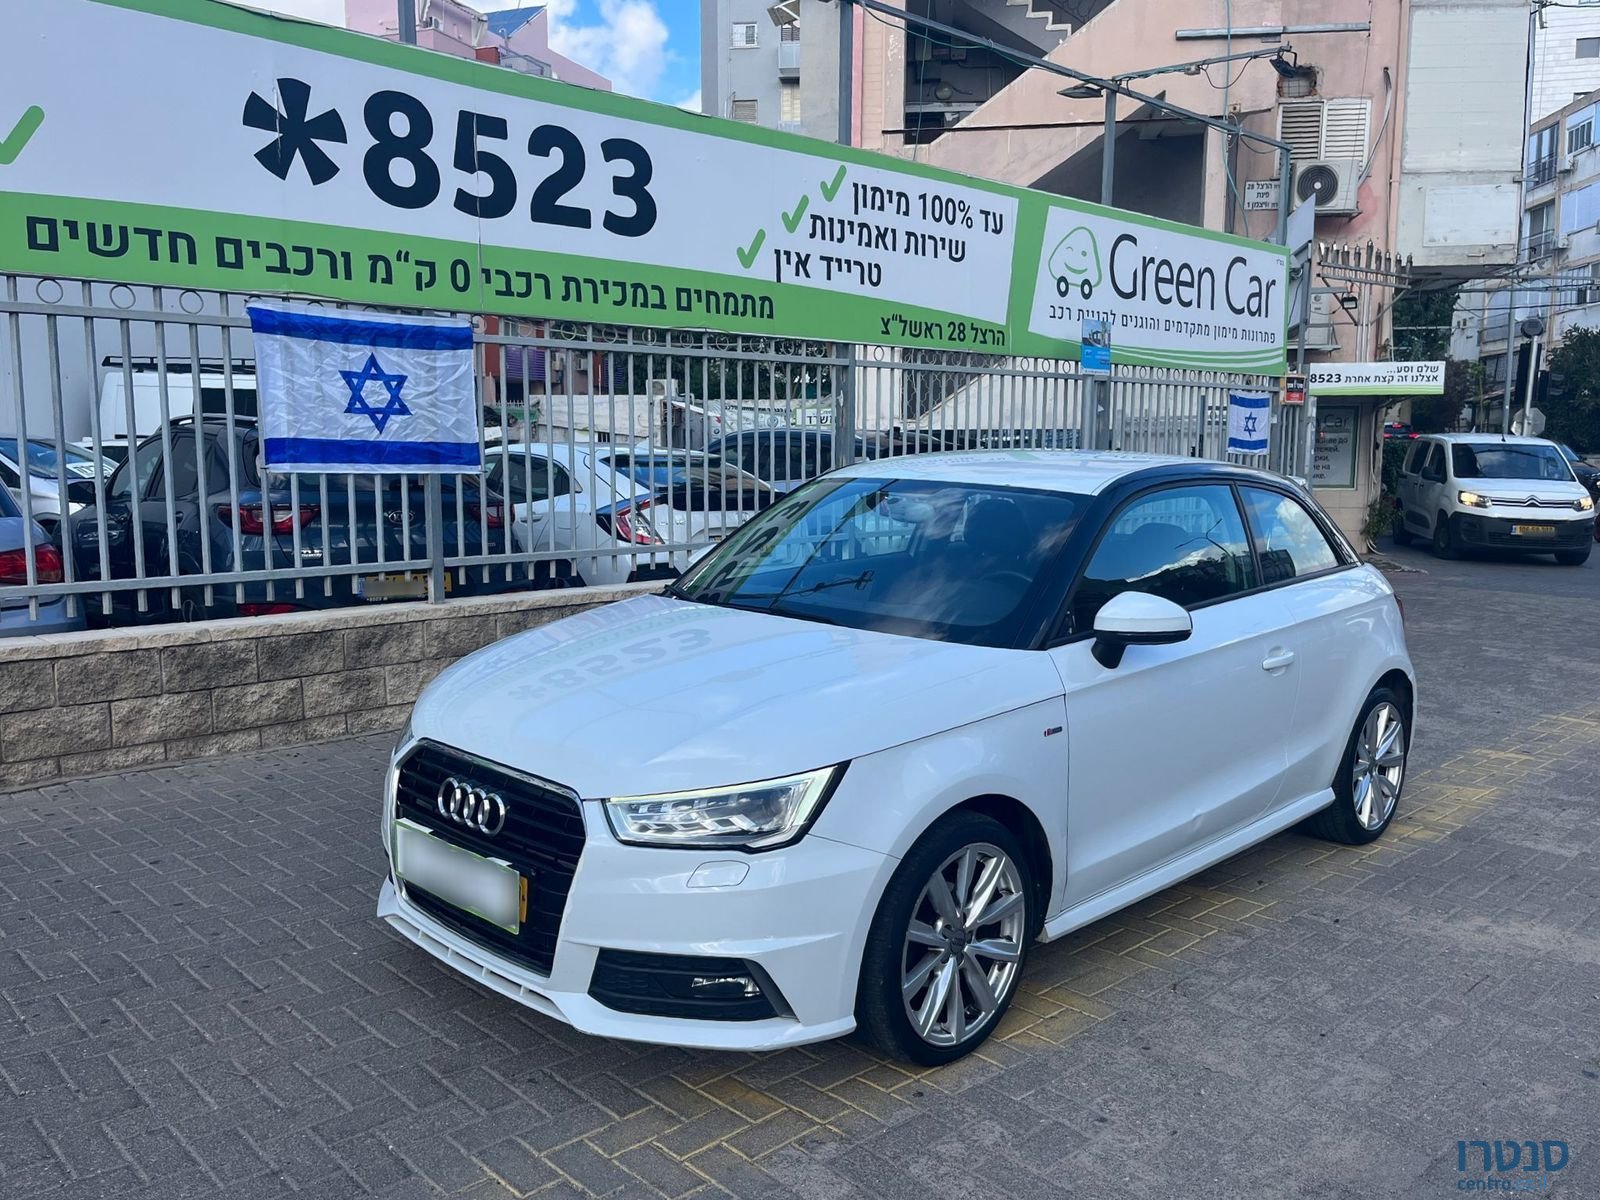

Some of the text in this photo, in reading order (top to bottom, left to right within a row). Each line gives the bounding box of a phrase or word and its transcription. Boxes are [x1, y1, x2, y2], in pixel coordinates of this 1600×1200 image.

[852, 182, 1004, 235] עד 100% מימון
[26, 215, 197, 265] חדשים
[809, 213, 966, 262] שירות ואמינות
[215, 236, 352, 281] ורכבים
[774, 248, 882, 287] טרייד אין
[450, 258, 470, 293] 0
[481, 267, 551, 300] רכבי
[1109, 233, 1276, 318] Green Car
[561, 275, 667, 310] במכירת
[676, 286, 774, 319] מתמחים
[1049, 304, 1072, 321] רכב
[1121, 313, 1160, 331] והוגנים
[947, 321, 966, 342] 28
[971, 322, 1005, 347] הרצל
[1164, 320, 1210, 340] מתקדמים
[1214, 322, 1238, 341] מימון
[1241, 327, 1276, 344] פתרונות
[1310, 373, 1439, 384] אצלנו זה קצת אחרת 8523
[1417, 363, 1439, 373] שלם
